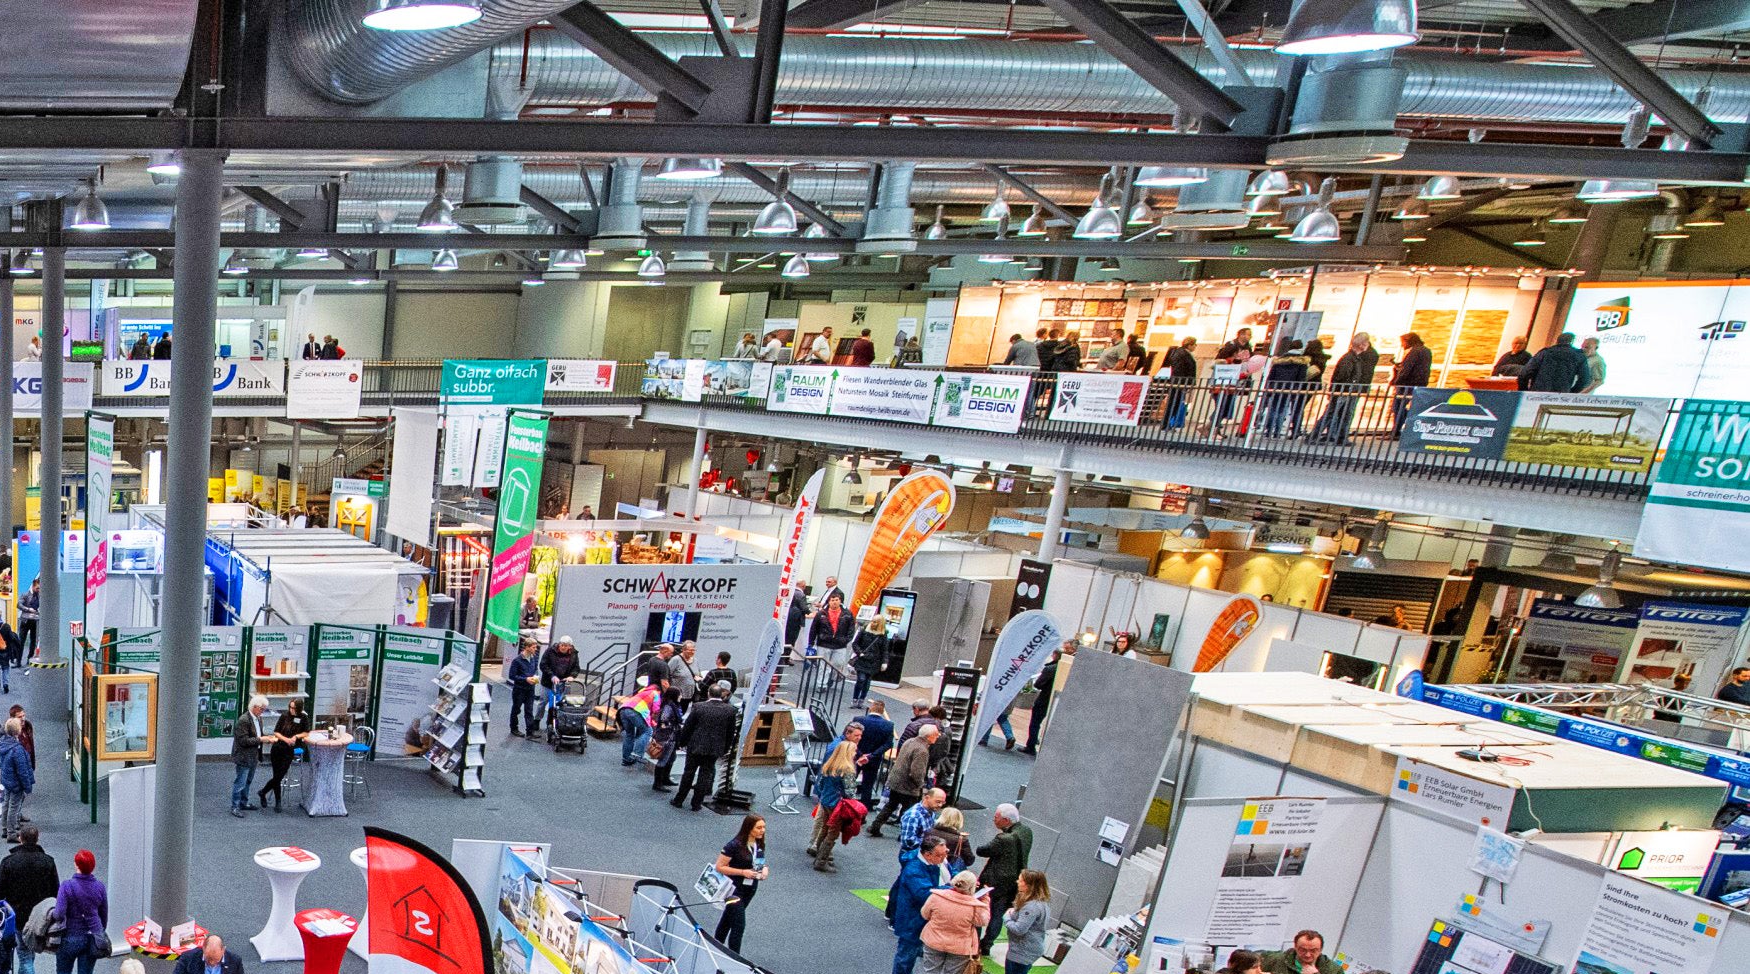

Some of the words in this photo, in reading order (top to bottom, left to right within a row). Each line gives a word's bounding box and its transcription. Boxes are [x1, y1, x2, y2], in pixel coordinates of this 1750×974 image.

[115, 368, 134, 379] BB
[455, 365, 491, 378] Ganz
[495, 364, 538, 379] oifach
[238, 377, 271, 389] Bank
[453, 380, 496, 393] subbr.
[792, 375, 827, 386] RAUM
[843, 375, 862, 384] Fliesen
[864, 376, 913, 387] Wandverblender
[914, 378, 928, 388] Glas
[1062, 381, 1082, 390] GERU
[790, 387, 824, 398] DESIGN
[838, 387, 867, 396] Naturstein
[869, 388, 889, 398] Mosaik
[891, 388, 928, 401] Steinfurnier
[970, 385, 1019, 400] RAUM
[967, 400, 1016, 414] DESIGN
[603, 571, 738, 599] SCHWARZKOPF
[607, 602, 639, 611] Planung
[649, 602, 684, 611] Fertigung
[695, 602, 728, 610] Montage
[255, 635, 288, 643] Keilbach
[994, 624, 1053, 692] SCHWARZKOPF
[1583, 724, 1617, 739] POLIZEI
[1425, 776, 1439, 785] EEB
[1441, 780, 1458, 791] Solar
[1460, 786, 1484, 798] GmbH
[1422, 791, 1436, 800] Lars
[1423, 783, 1469, 801] Erneuerbare
[1469, 797, 1502, 812] Energien
[1650, 854, 1684, 864] PRIOR
[1606, 883, 1624, 896] Sind
[1624, 889, 1640, 900] Ihre
[1603, 893, 1650, 915] Stromkosten
[1652, 910, 1662, 919] zu
[1663, 913, 1689, 928] hoch?
